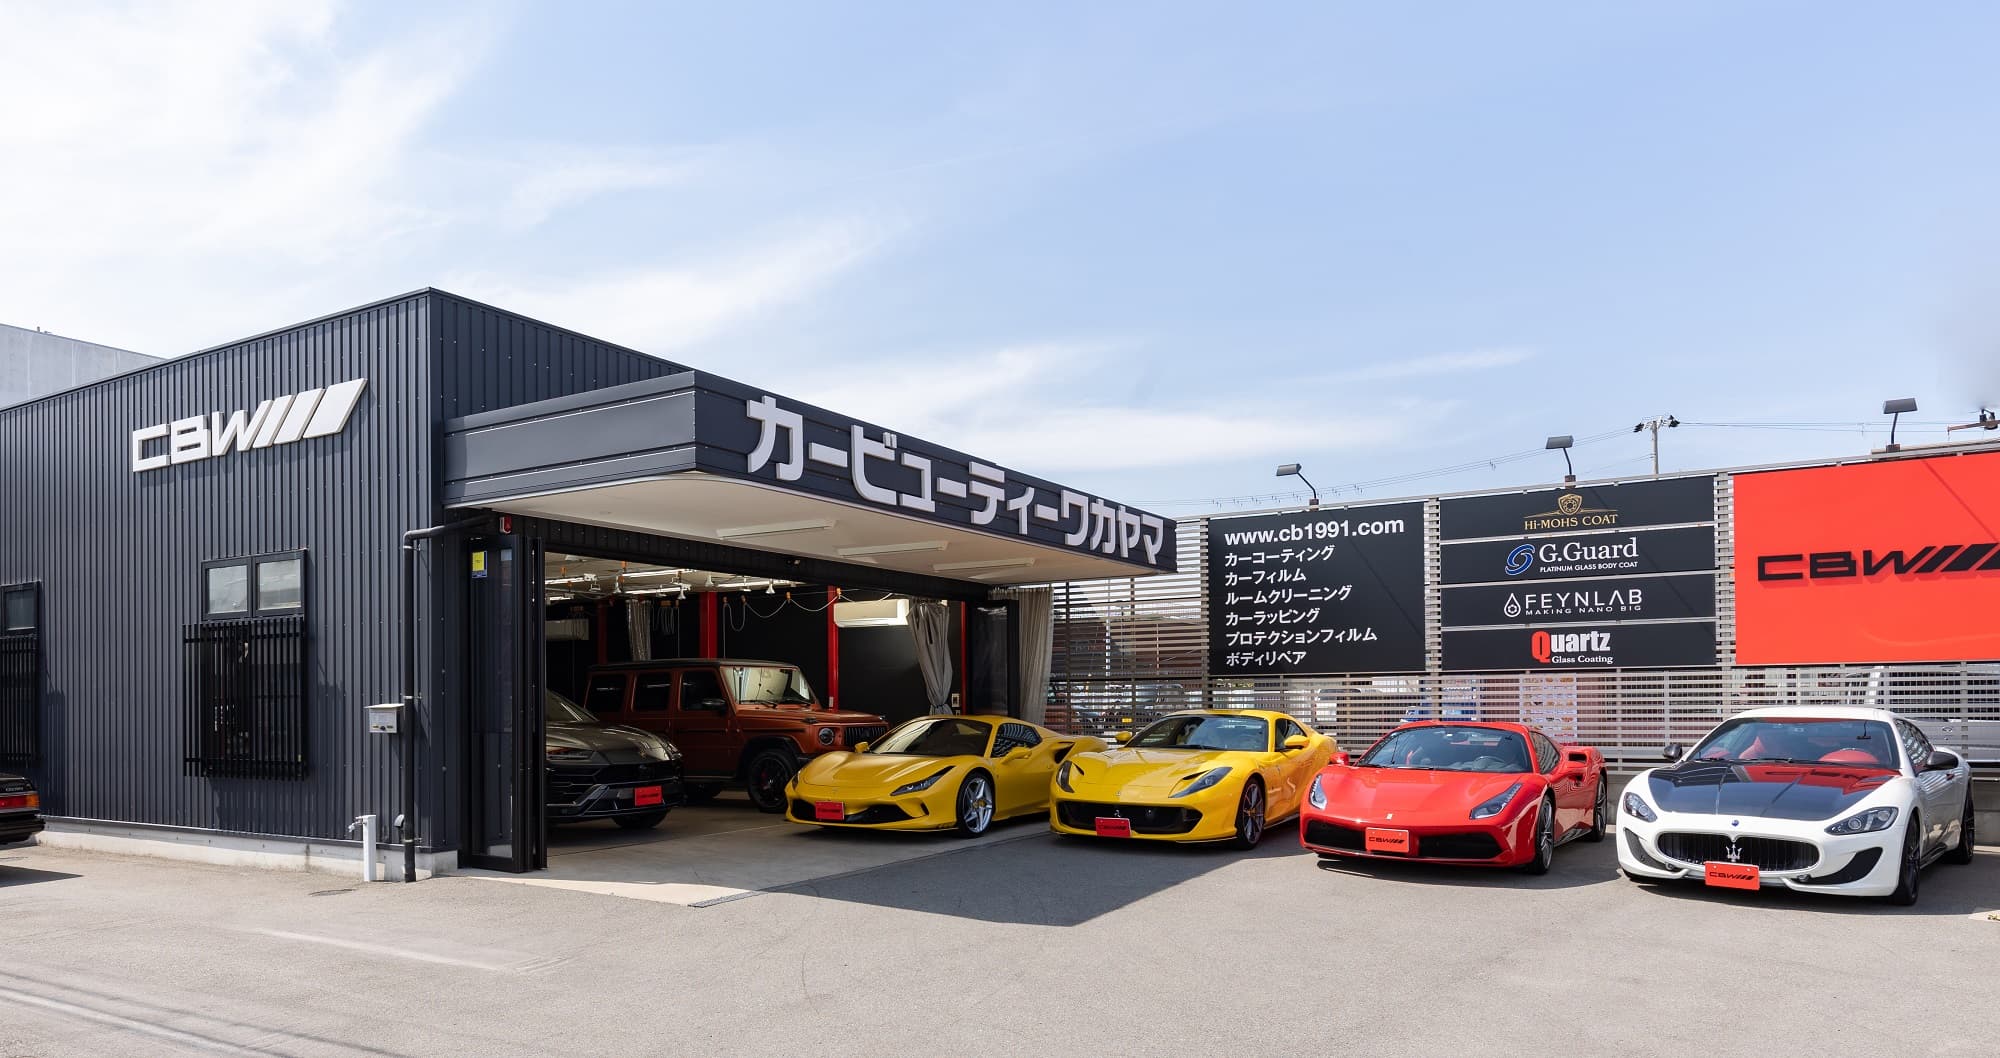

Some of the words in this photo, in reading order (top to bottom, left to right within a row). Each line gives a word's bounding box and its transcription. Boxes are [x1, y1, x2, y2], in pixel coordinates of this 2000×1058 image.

[746, 394, 1164, 565] カービューティーワカヤマ
[1582, 514, 1618, 526] COAT
[1224, 519, 1405, 546] www.cb1991.com
[1224, 545, 1336, 567] カーコーティング
[1539, 536, 1640, 563] G.Guard
[1540, 565, 1573, 573] PLATINUM
[1574, 563, 1597, 571] GLASS
[1598, 562, 1618, 570] BODY
[1618, 561, 1639, 569] COAT
[1225, 568, 1307, 587] カーフィルム
[1225, 584, 1353, 605] ルームクリーニング
[1525, 589, 1642, 609] FEYNLAB
[1225, 607, 1320, 627] カーラッピング
[1525, 608, 1572, 616] MAKING
[1579, 606, 1613, 614] NANO
[1620, 604, 1642, 612] BIG
[1226, 627, 1378, 647] プロテクションフィルム
[1531, 630, 1611, 664] Quartz
[1226, 650, 1307, 667] ボディリペア
[1551, 656, 1576, 664] Glass
[1577, 655, 1614, 665] Coating
